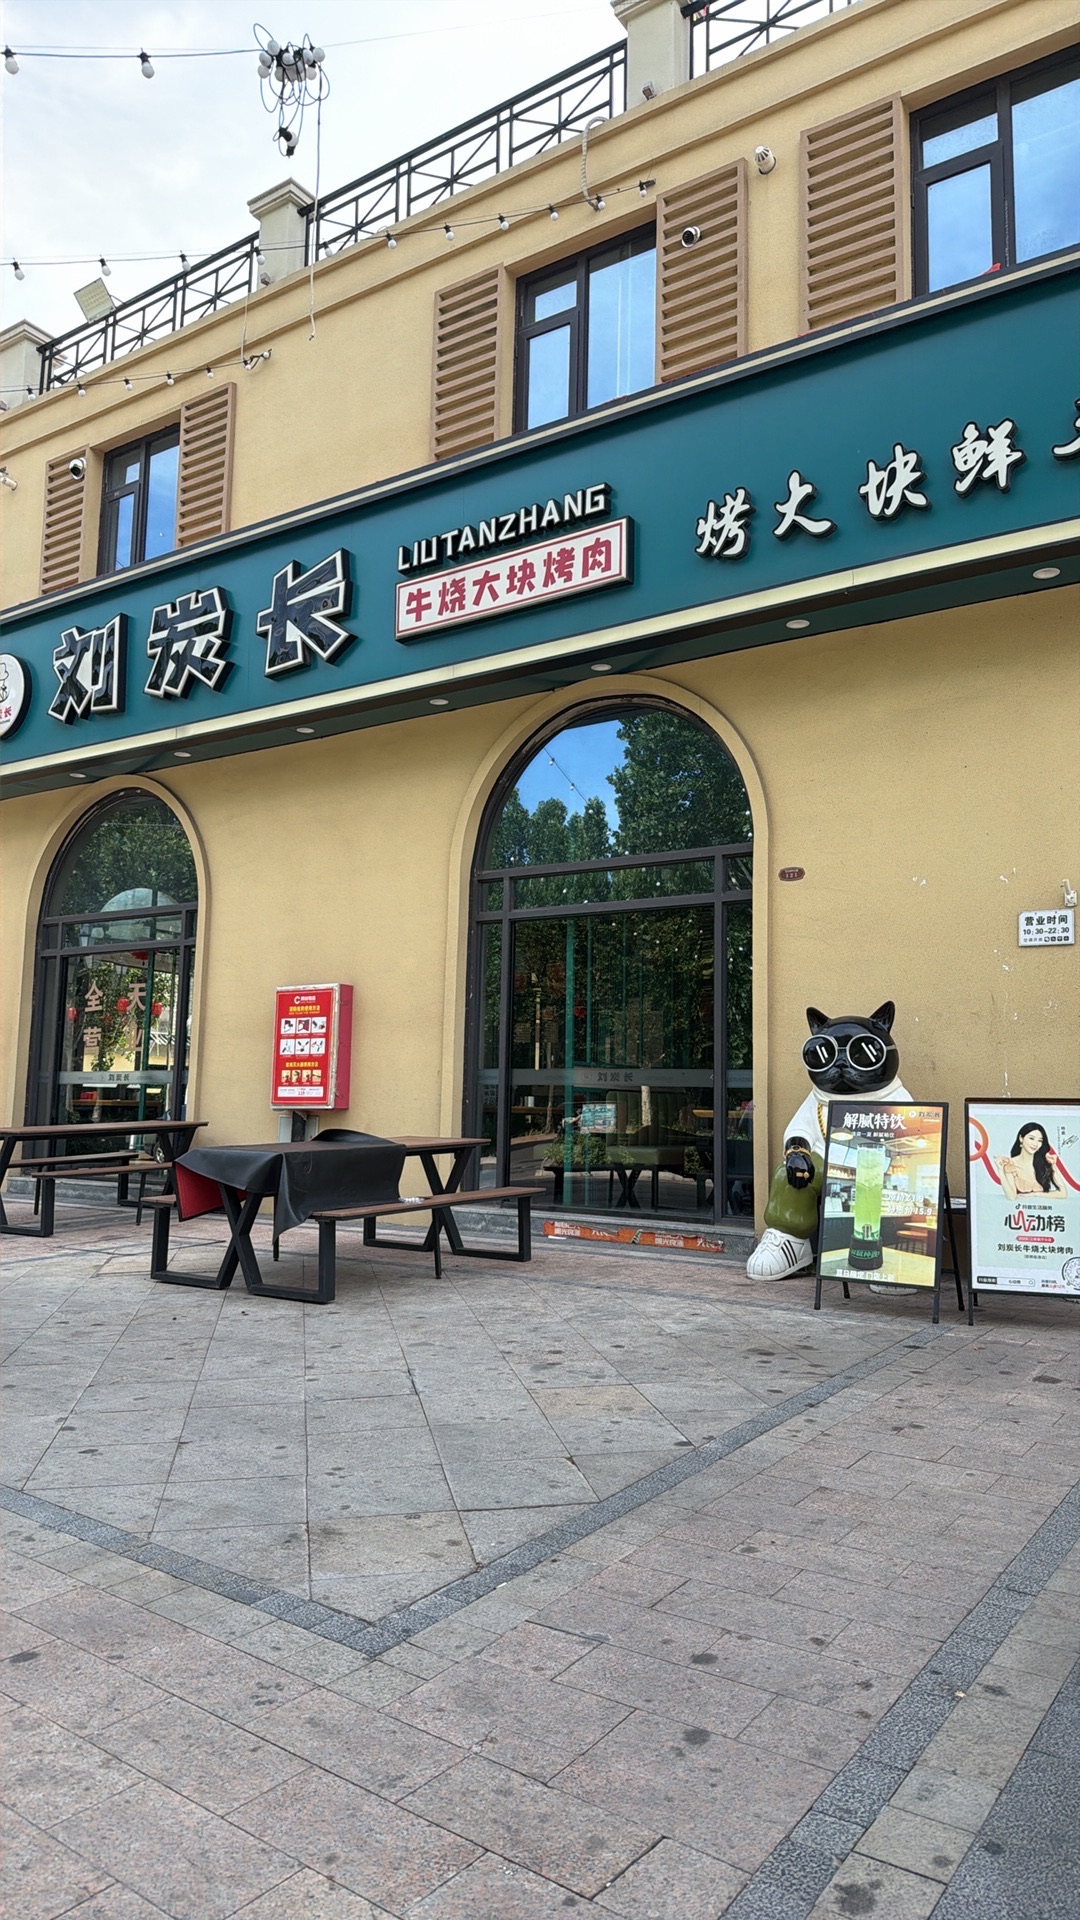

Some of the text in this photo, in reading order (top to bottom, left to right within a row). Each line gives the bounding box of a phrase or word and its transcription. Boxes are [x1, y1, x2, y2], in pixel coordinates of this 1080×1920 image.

[398, 483, 611, 573] LIUTANZHANG
[405, 537, 614, 624] 牛烧大块烤肉
[47, 547, 355, 724] 刘炭长
[1024, 914, 1068, 926] 营业时间
[842, 1112, 907, 1130] 解腻特饮
[1004, 1210, 1065, 1233] 心动榜
[997, 1243, 1074, 1255] 刘炭长牛烧大块烤肉
